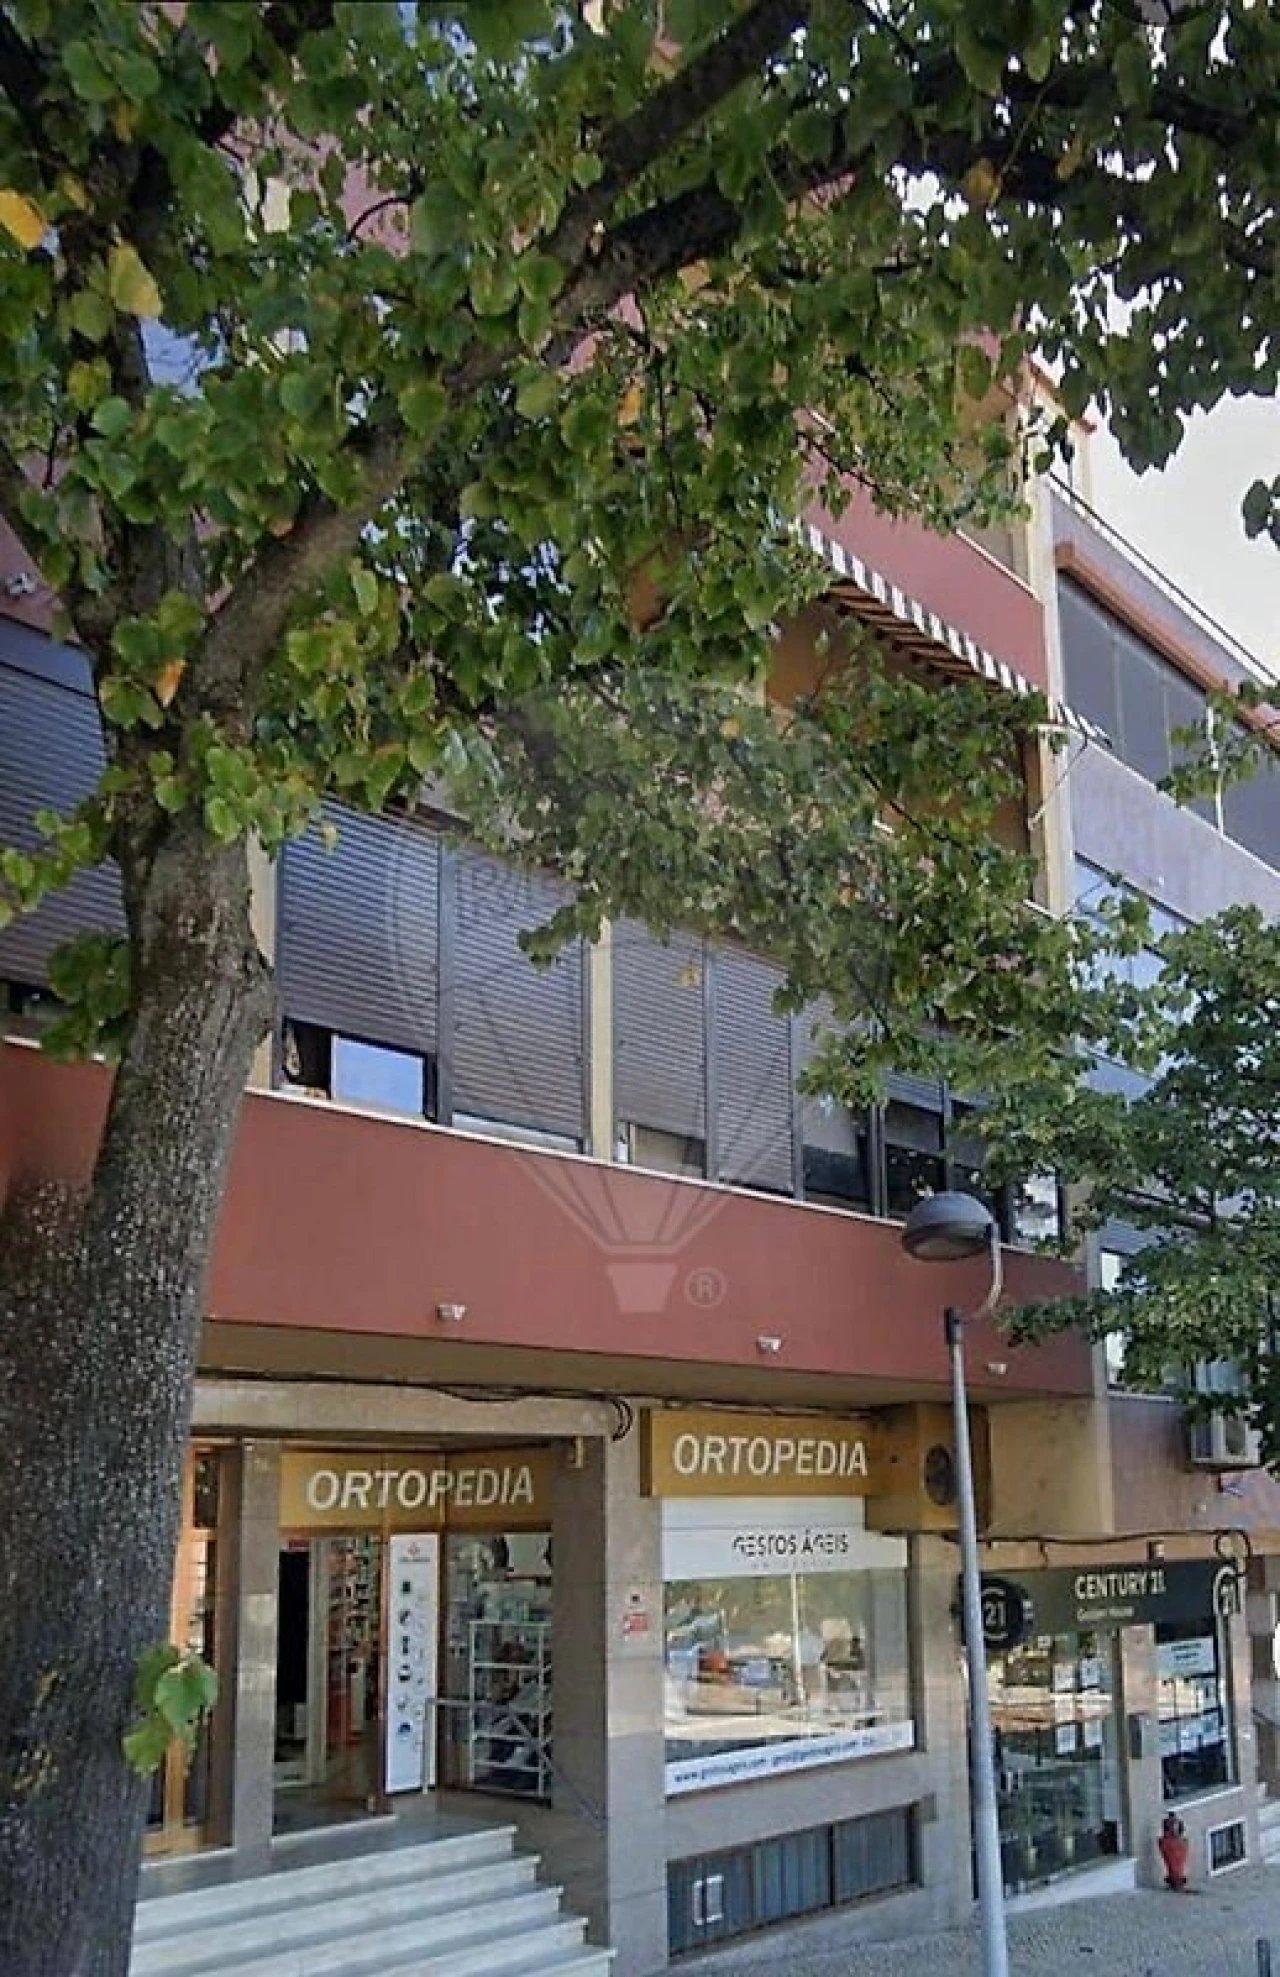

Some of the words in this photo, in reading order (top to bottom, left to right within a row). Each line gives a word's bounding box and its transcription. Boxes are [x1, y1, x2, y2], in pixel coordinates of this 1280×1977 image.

[673, 1434, 868, 1477] ORTOPEDIA
[306, 1466, 535, 1511] ORTOPEDIA
[1075, 1572, 1147, 1600] CENTURY
[1150, 1568, 1167, 1594] 21
[985, 1600, 1007, 1627] 21
